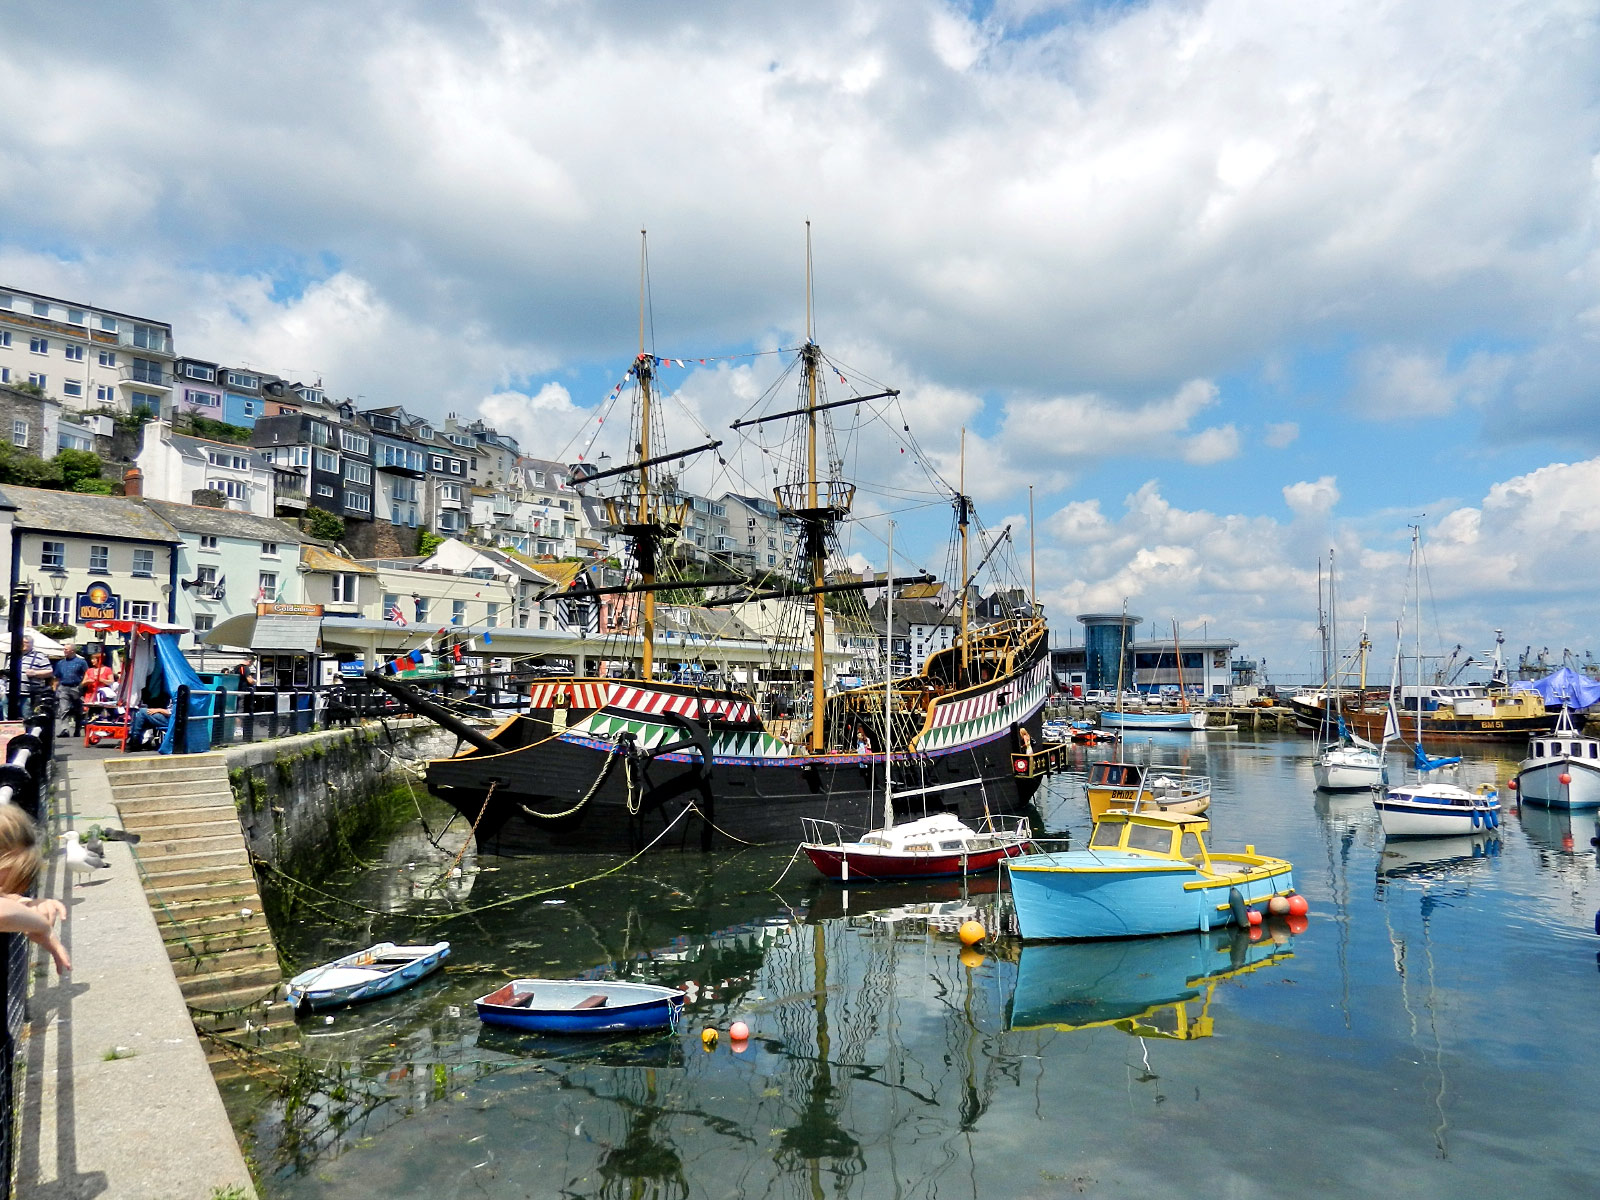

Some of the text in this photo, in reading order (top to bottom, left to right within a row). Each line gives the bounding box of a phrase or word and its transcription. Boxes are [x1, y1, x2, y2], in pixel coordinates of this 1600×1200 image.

[81, 606, 115, 619] RISING SUN
[274, 604, 301, 612] Golden
